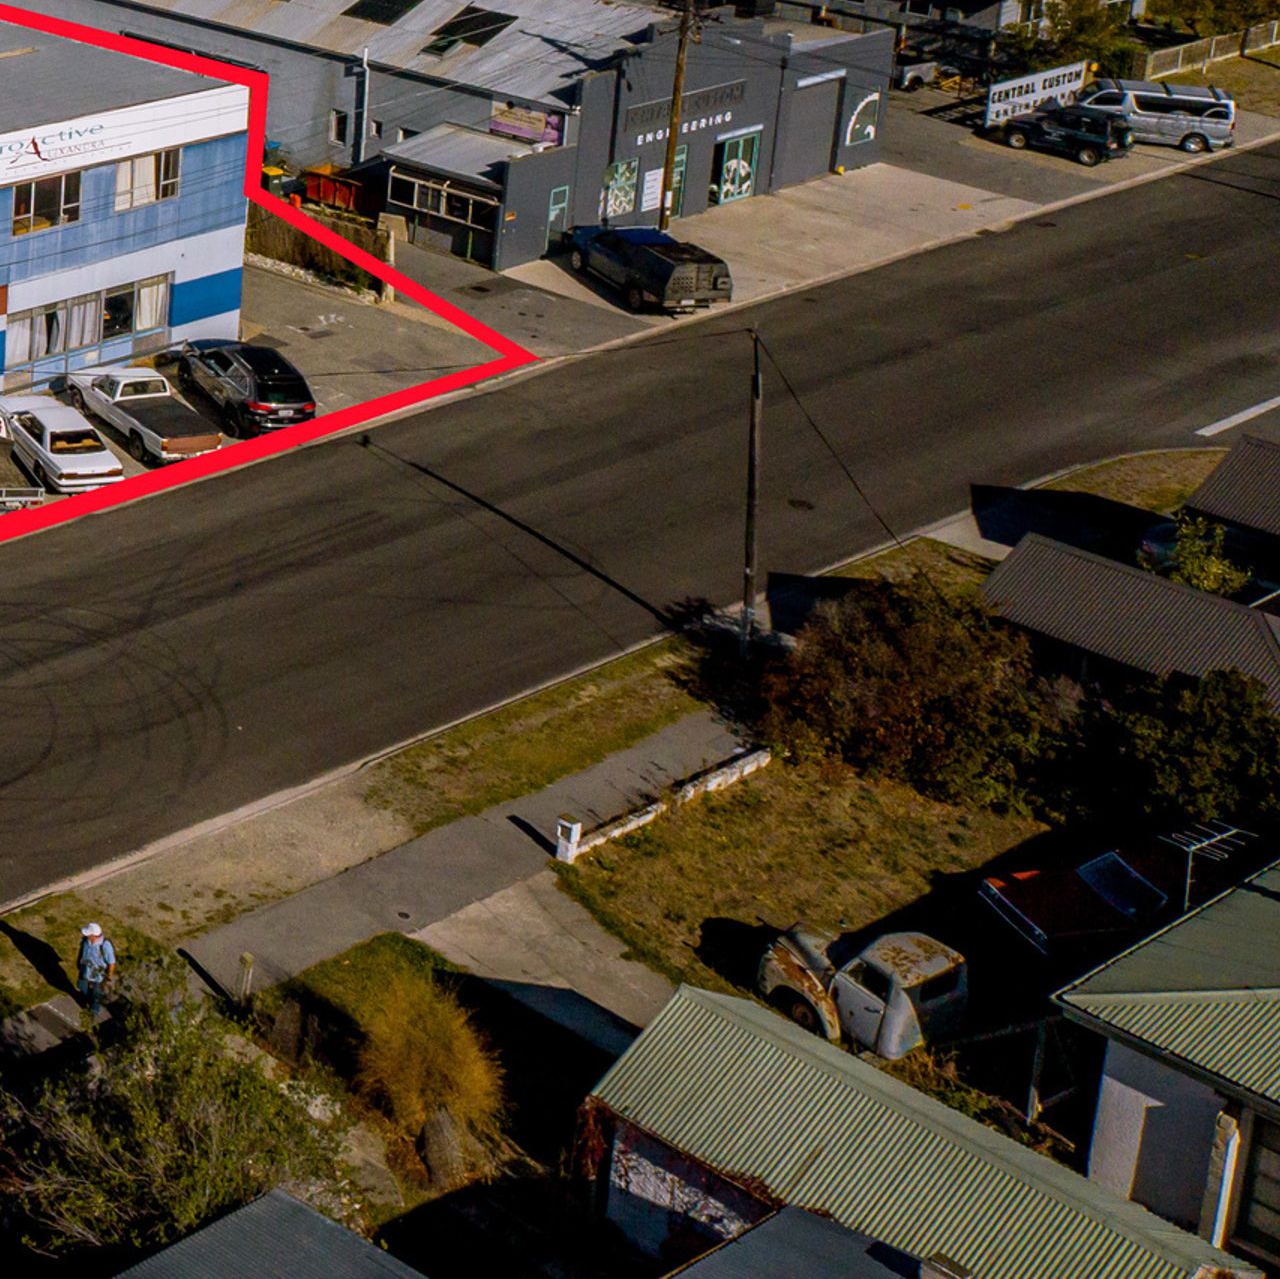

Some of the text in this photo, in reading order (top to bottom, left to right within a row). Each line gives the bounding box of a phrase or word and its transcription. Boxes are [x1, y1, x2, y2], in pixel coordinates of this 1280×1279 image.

[991, 70, 1083, 104] CENTRAL CUSTOM
[636, 111, 733, 145] ENGIEERING
